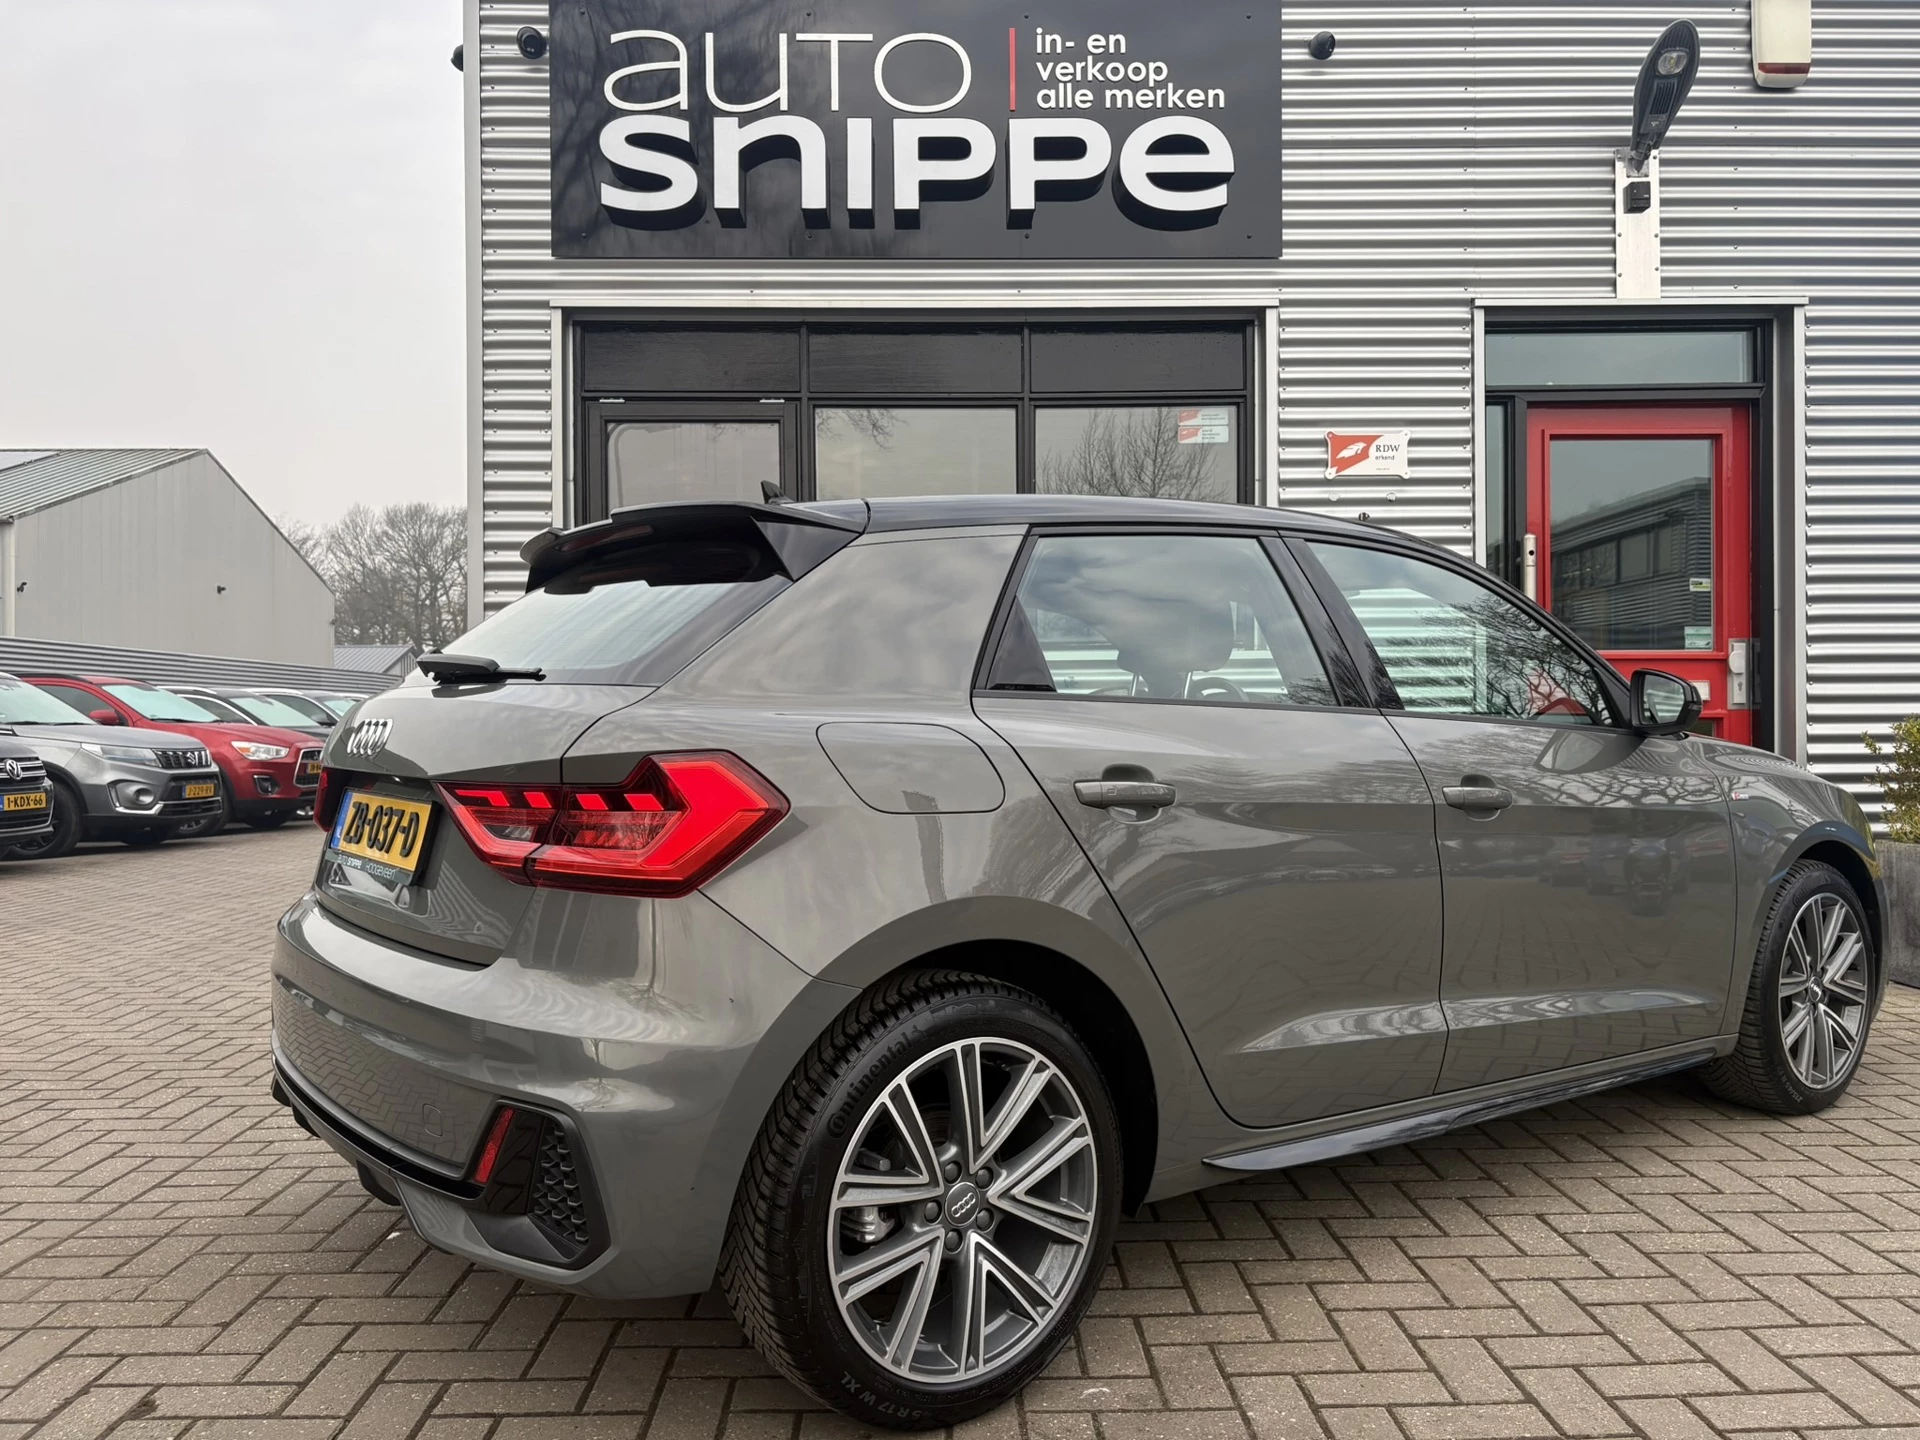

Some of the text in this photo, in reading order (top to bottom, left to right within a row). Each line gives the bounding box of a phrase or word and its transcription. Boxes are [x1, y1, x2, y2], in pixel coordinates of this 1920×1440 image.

[1036, 27, 1126, 54] in- en
[1036, 55, 1169, 87] verkoop
[1036, 82, 1225, 108] alle merken
[1375, 444, 1400, 453] RDW
[6, 795, 43, 808] 1-KDX-66
[343, 801, 420, 858] ZB-037-D
